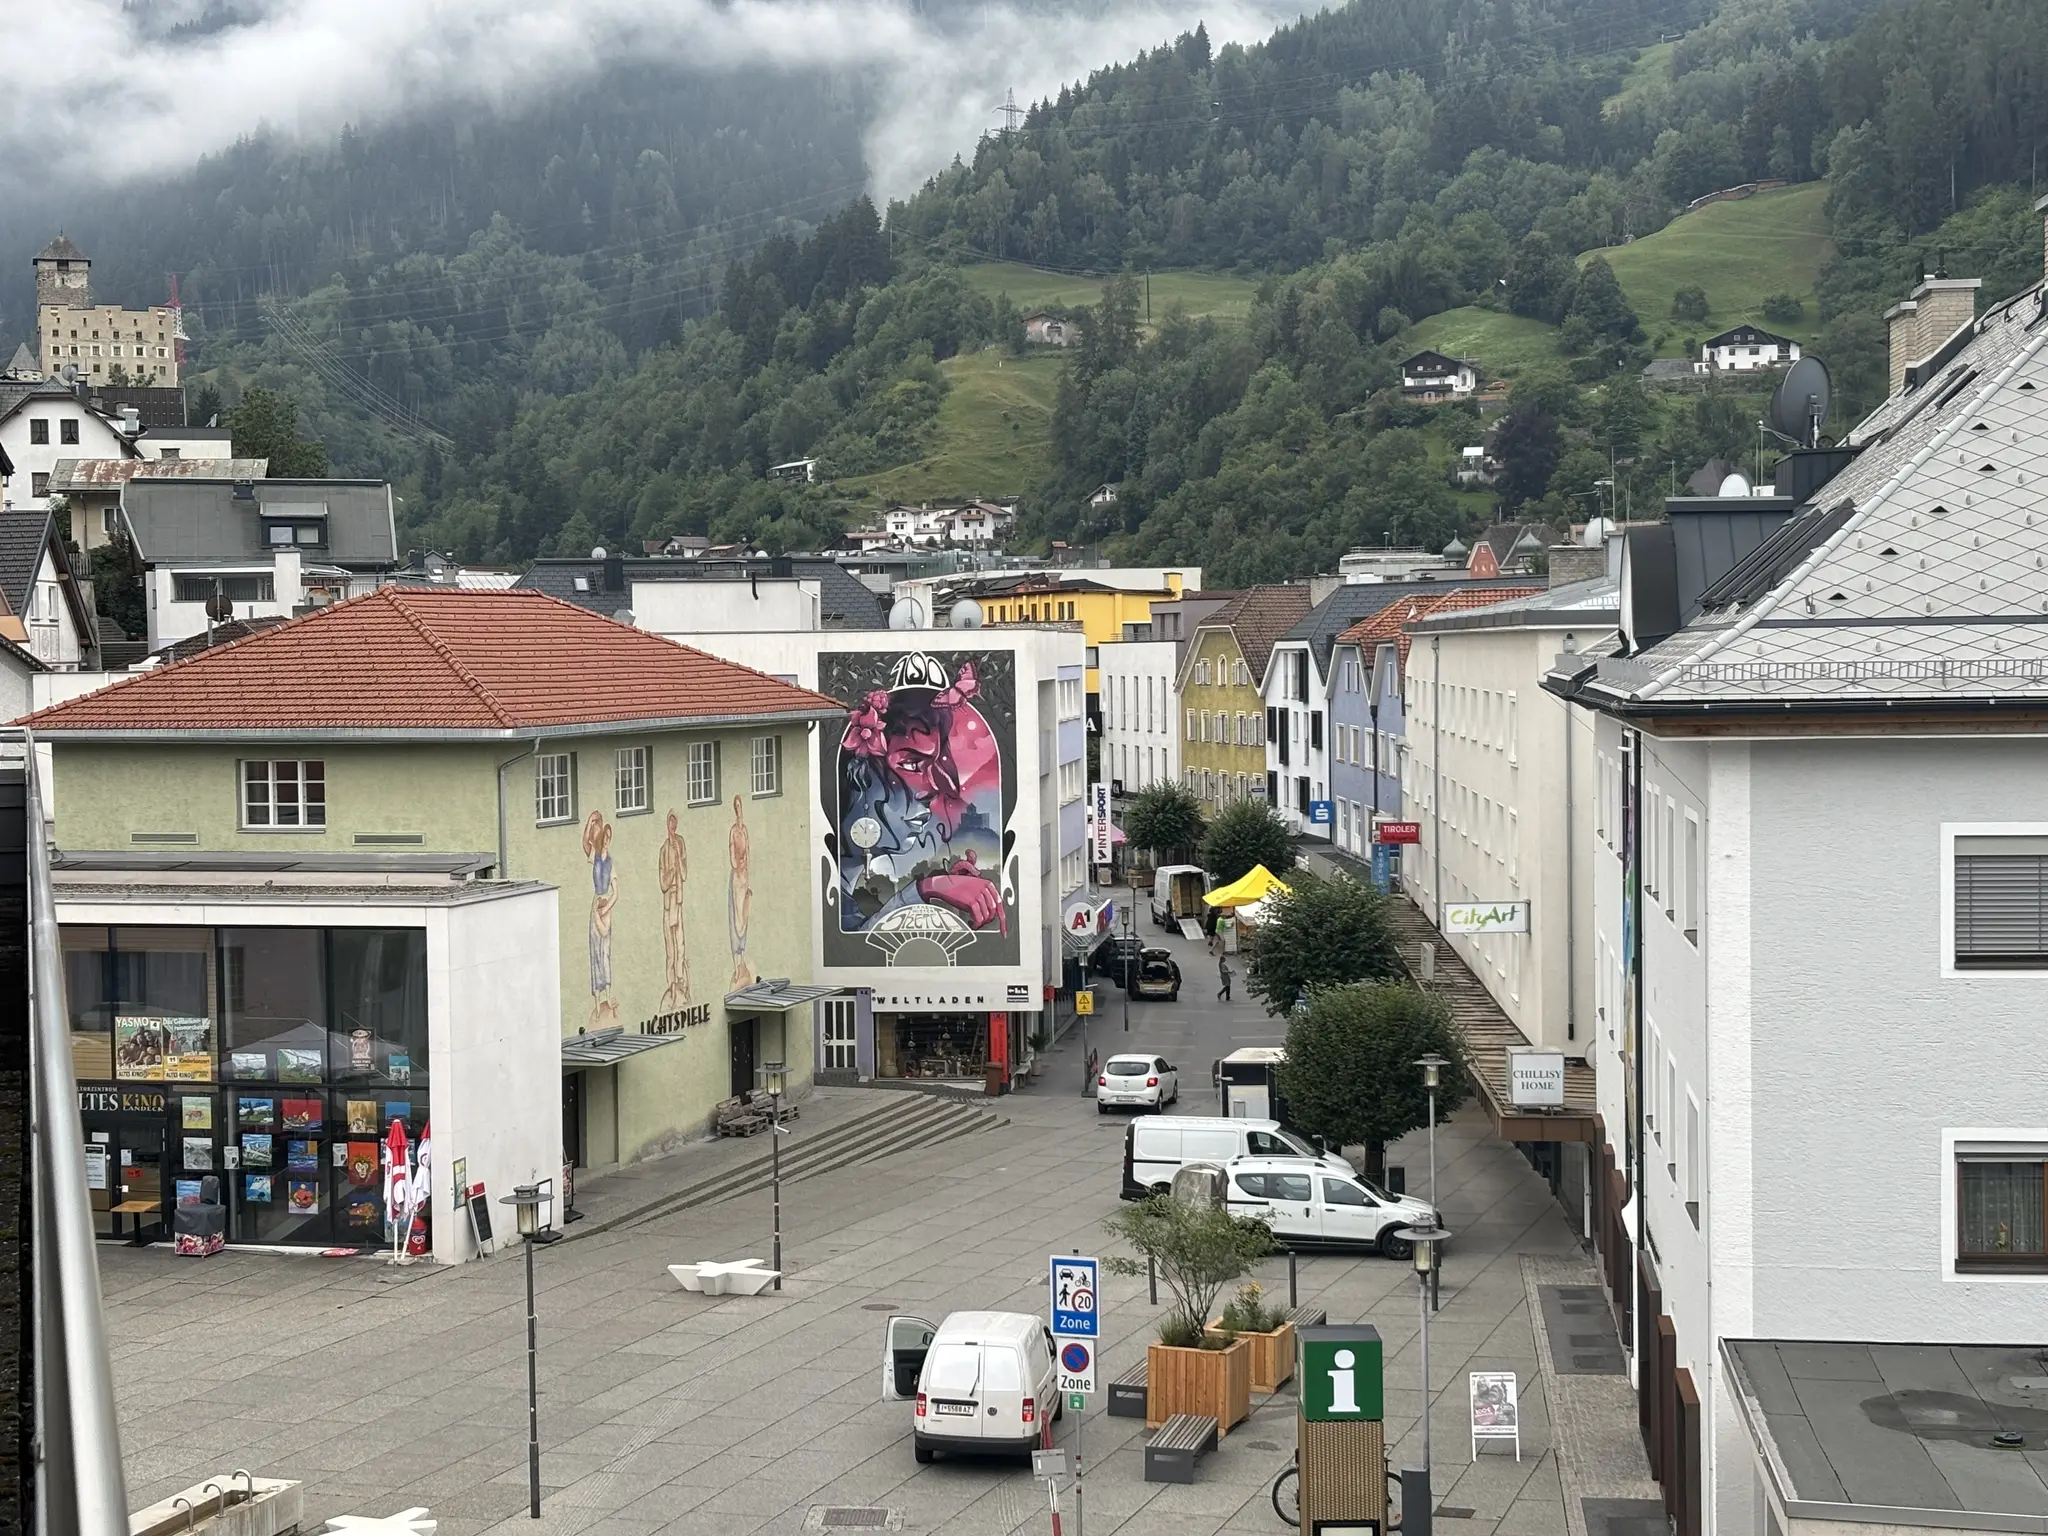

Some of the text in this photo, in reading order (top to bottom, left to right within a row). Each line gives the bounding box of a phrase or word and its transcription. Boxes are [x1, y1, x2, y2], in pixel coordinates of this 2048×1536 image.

[1097, 785, 1107, 849] INTERSPORT
[1383, 825, 1417, 833] TIROLER
[1071, 909, 1091, 930] A1
[1450, 904, 1520, 928] CityArt
[877, 996, 984, 1004] WELTLADEN
[115, 1017, 149, 1028] YASMO
[1513, 1070, 1562, 1079] CHILLISY
[1521, 1081, 1555, 1090] HOME
[78, 1093, 119, 1111] LTES
[1078, 1295, 1091, 1309] 20
[1060, 1315, 1091, 1329] Zone
[1061, 1375, 1091, 1390] Zone
[1327, 1349, 1361, 1412] i
